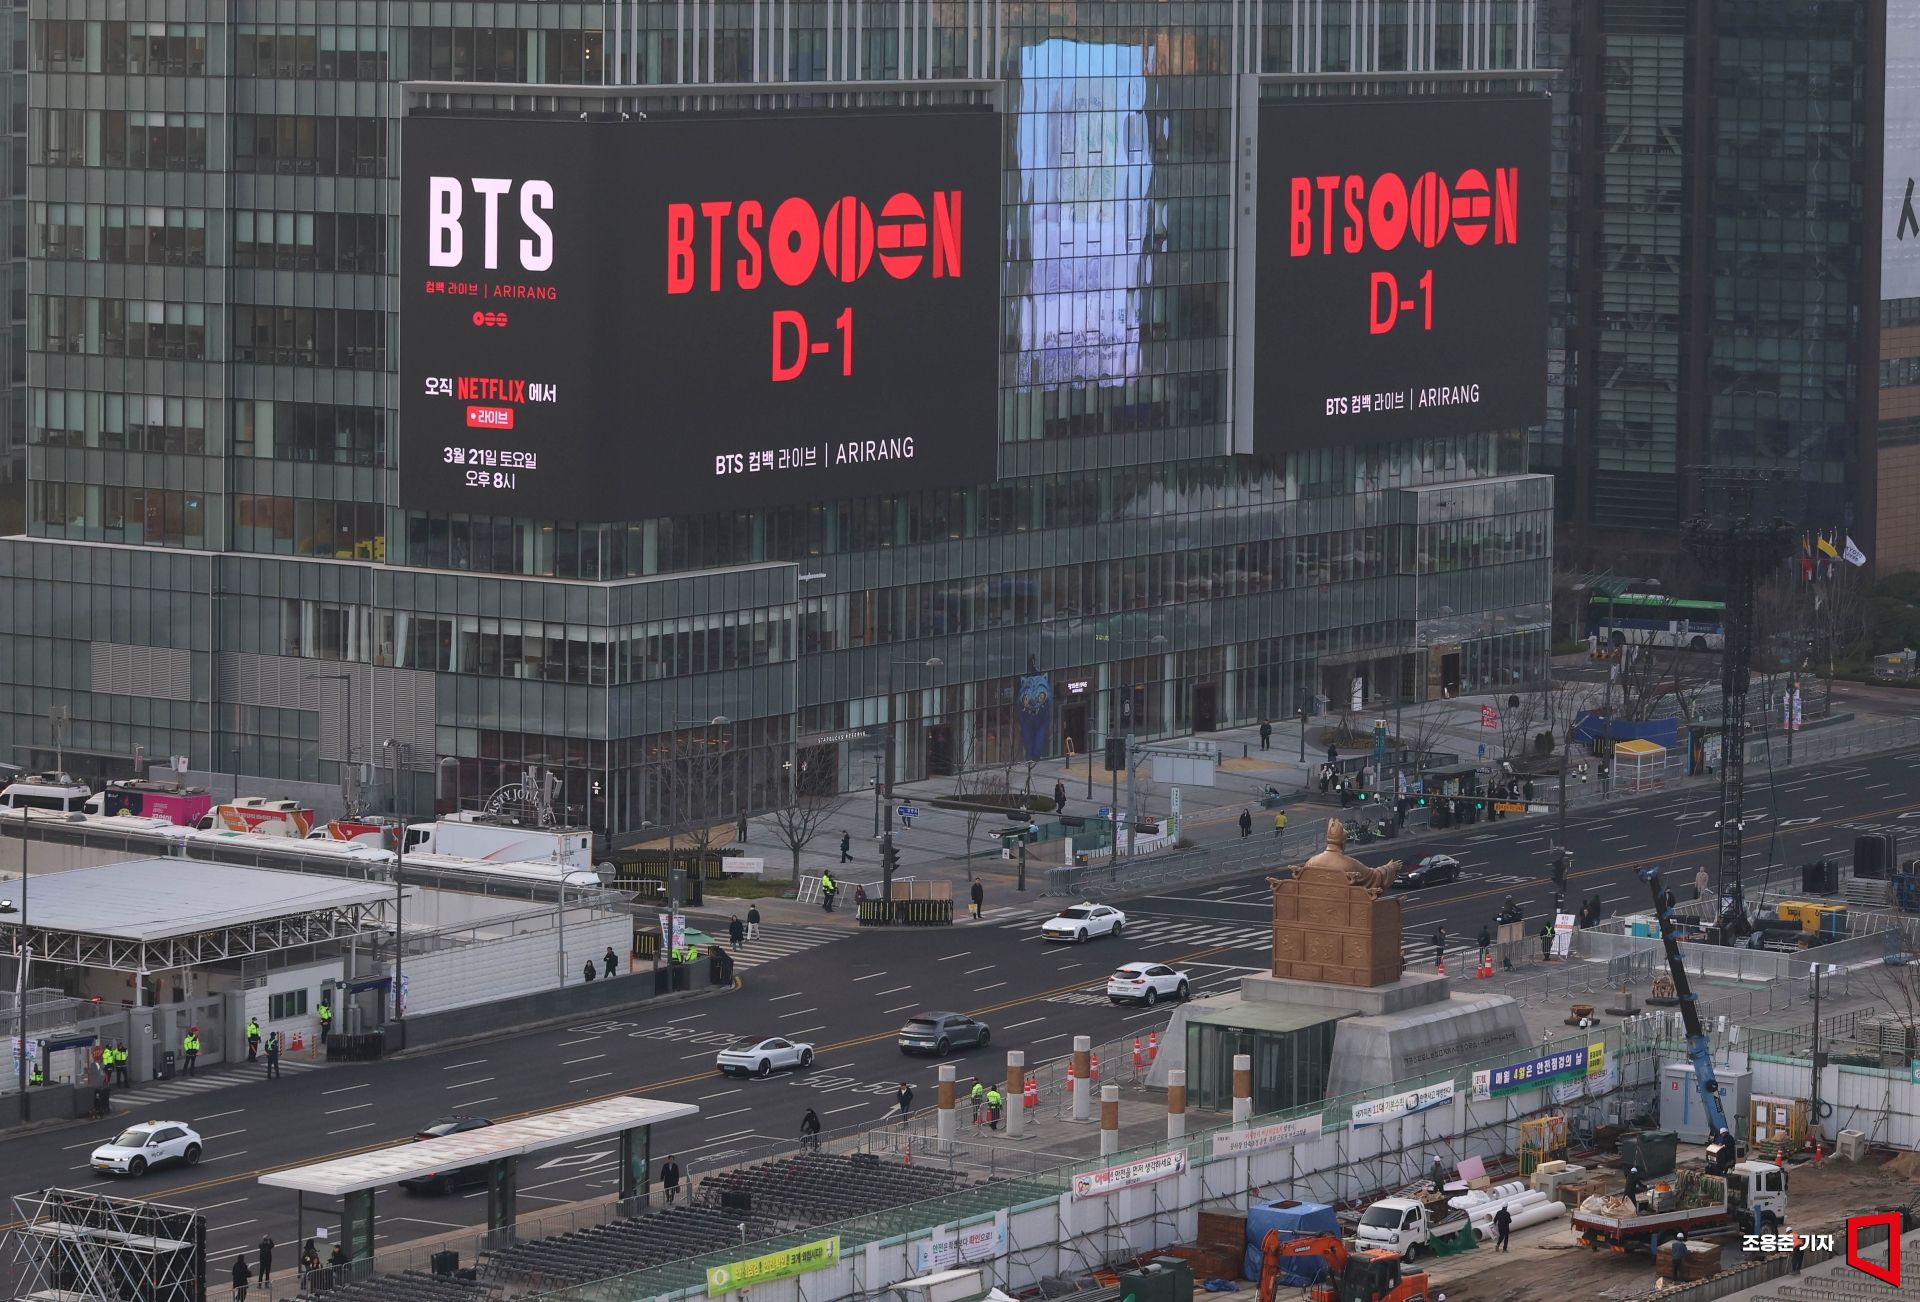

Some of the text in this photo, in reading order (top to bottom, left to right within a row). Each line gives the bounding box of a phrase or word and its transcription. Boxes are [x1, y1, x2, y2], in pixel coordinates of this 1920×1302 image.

[429, 176, 554, 272] BTS
[425, 281, 557, 301] 컴백 라이브 ARIRANG
[1370, 269, 1433, 335] D-1
[772, 307, 852, 382] D-1
[425, 376, 557, 404] 오직 NETFLIX 에서
[1326, 383, 1480, 416] BTS 컴백 라이브 ARIRANG
[478, 410, 509, 425] 라이브
[443, 447, 537, 470] 3월 21일 토요일
[716, 437, 914, 475] BTS 컴백 라이브 ARIRANG
[465, 470, 515, 490] 오후 8시
[1536, 1054, 1572, 1075] 안전점검의
[1575, 1052, 1583, 1066] 날
[1132, 1166, 1144, 1176] 먼저
[1145, 1157, 1172, 1173] 생각하세요
[969, 1232, 993, 1245] 확인으로!
